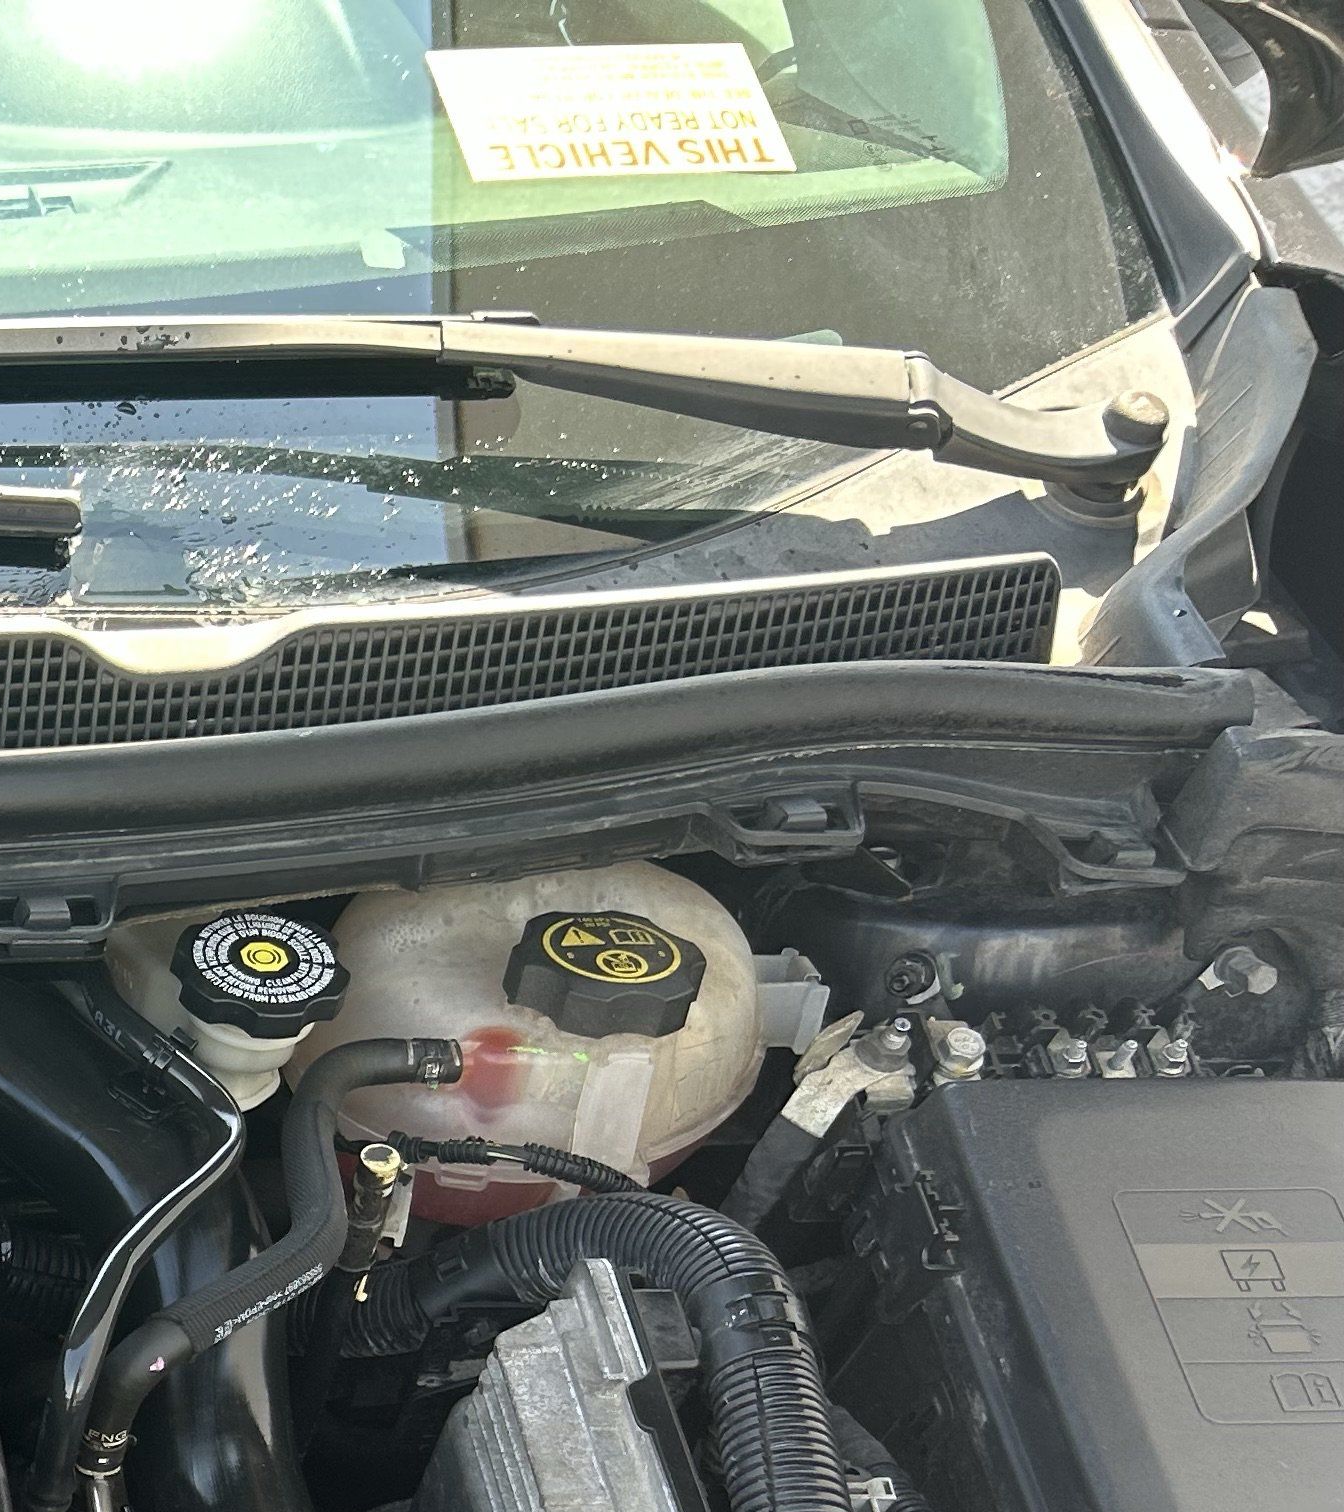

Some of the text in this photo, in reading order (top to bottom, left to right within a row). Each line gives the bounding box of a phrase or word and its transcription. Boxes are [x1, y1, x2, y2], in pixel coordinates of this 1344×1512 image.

[616, 109, 699, 130] READY
[709, 109, 757, 129] NOT
[488, 137, 776, 171] THIS VEHICLE
[285, 921, 313, 936] AVANT
[265, 976, 295, 987] CLEAN
